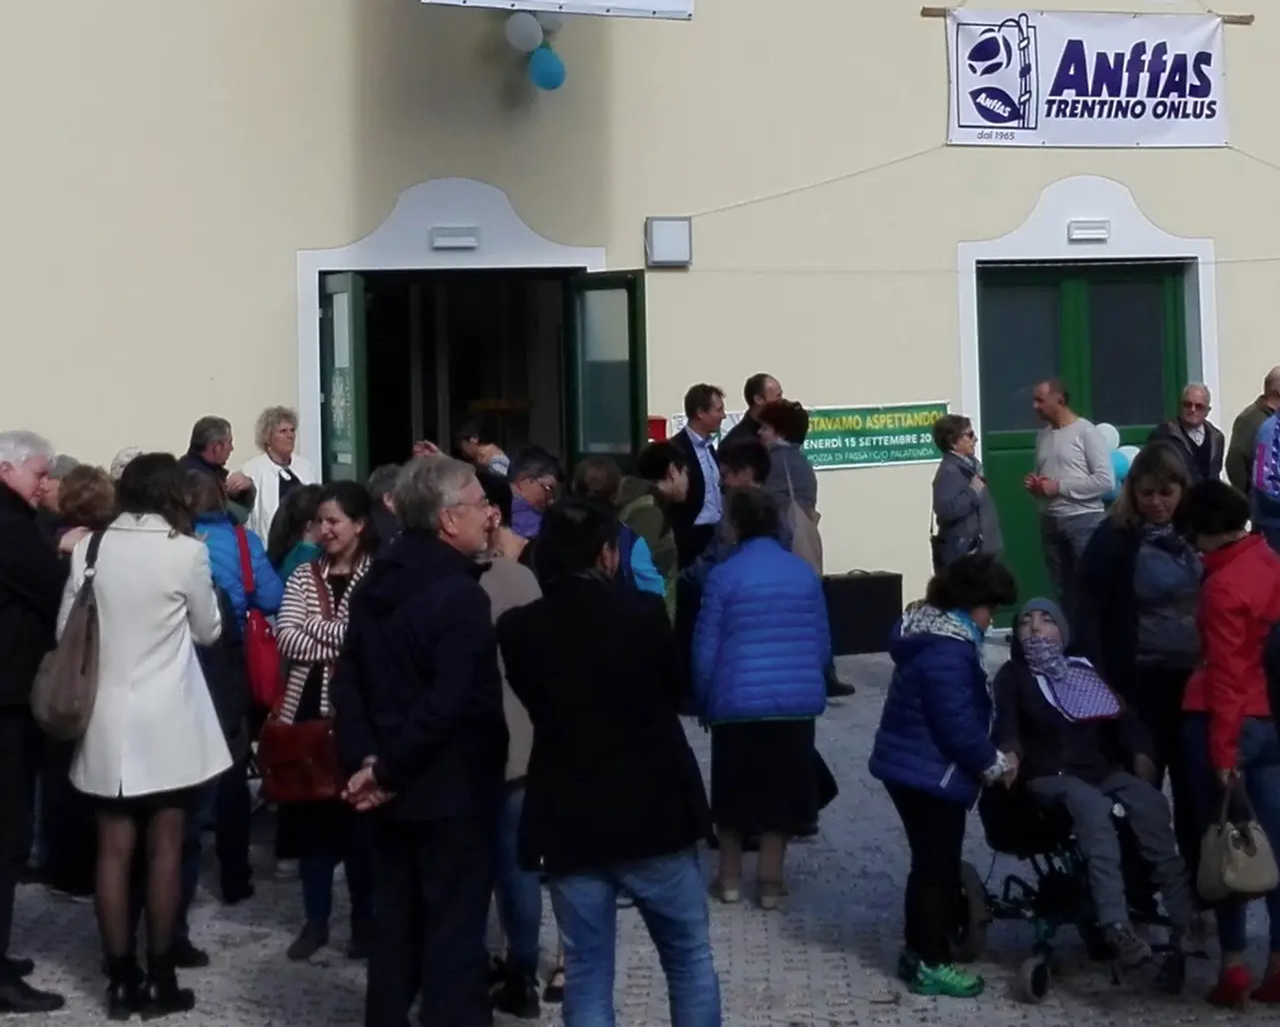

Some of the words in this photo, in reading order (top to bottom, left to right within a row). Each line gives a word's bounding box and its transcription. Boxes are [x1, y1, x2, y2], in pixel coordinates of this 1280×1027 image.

[1045, 99, 1147, 119] TRENTINO
[1152, 100, 1217, 120] ONLUS
[976, 131, 993, 140] dal
[995, 131, 1015, 141] 1965
[802, 434, 842, 449] ENERDÌ
[845, 437, 856, 448] 15
[858, 434, 918, 447] SETTEMBRE
[919, 433, 932, 444] 20
